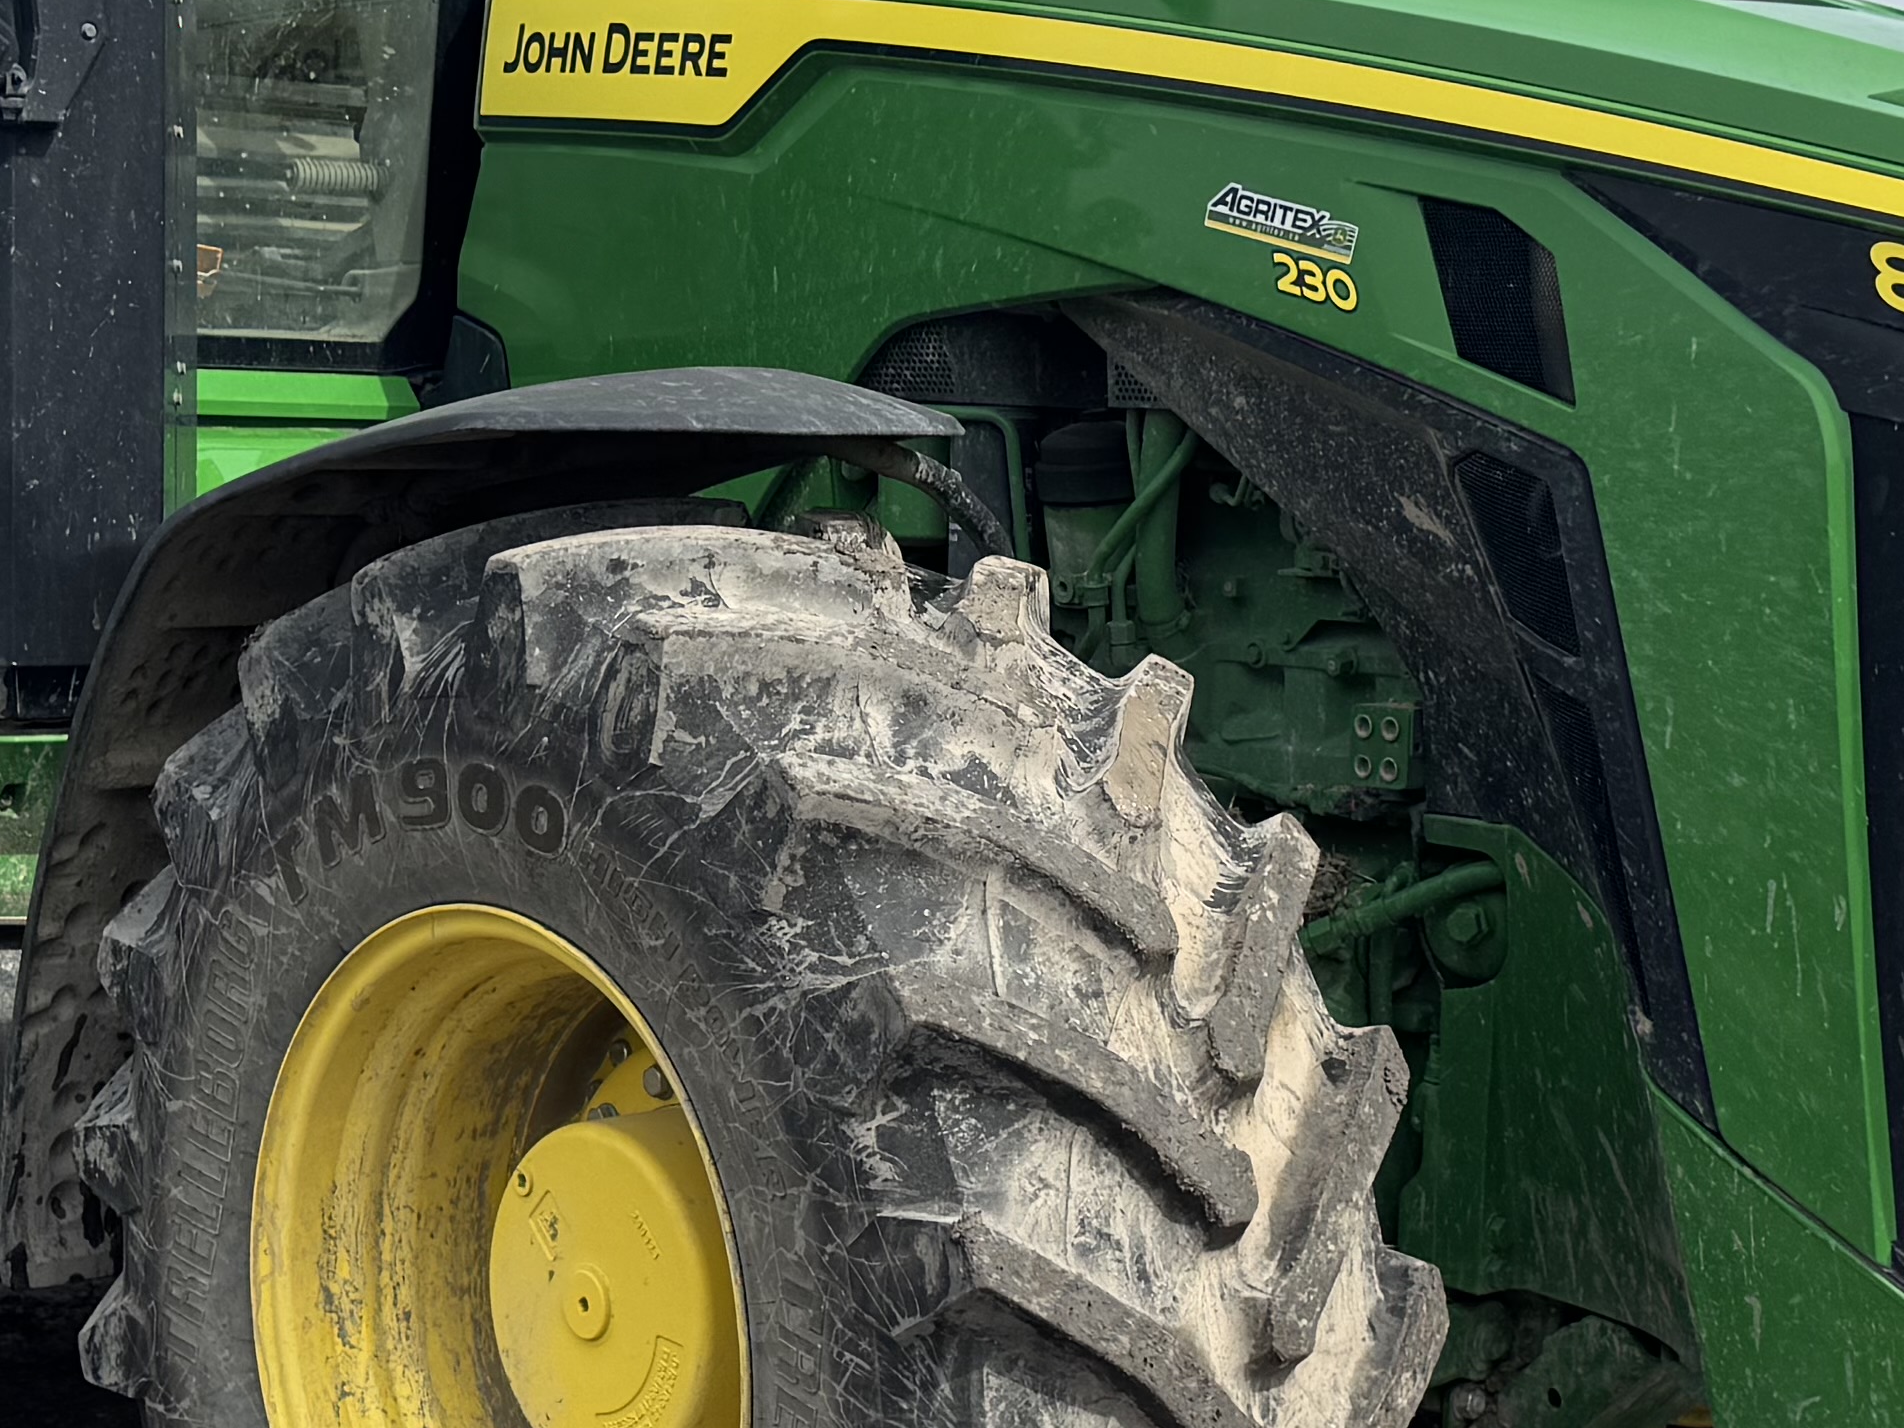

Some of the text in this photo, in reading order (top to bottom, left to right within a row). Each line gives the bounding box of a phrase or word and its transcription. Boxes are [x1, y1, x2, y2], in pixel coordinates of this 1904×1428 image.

[503, 22, 733, 78] JOHN DEERE
[1211, 187, 1328, 237] AGRITEX
[1272, 252, 1359, 312] 230
[259, 757, 568, 907] TM900
[164, 908, 257, 1363] TRELLEBORG
